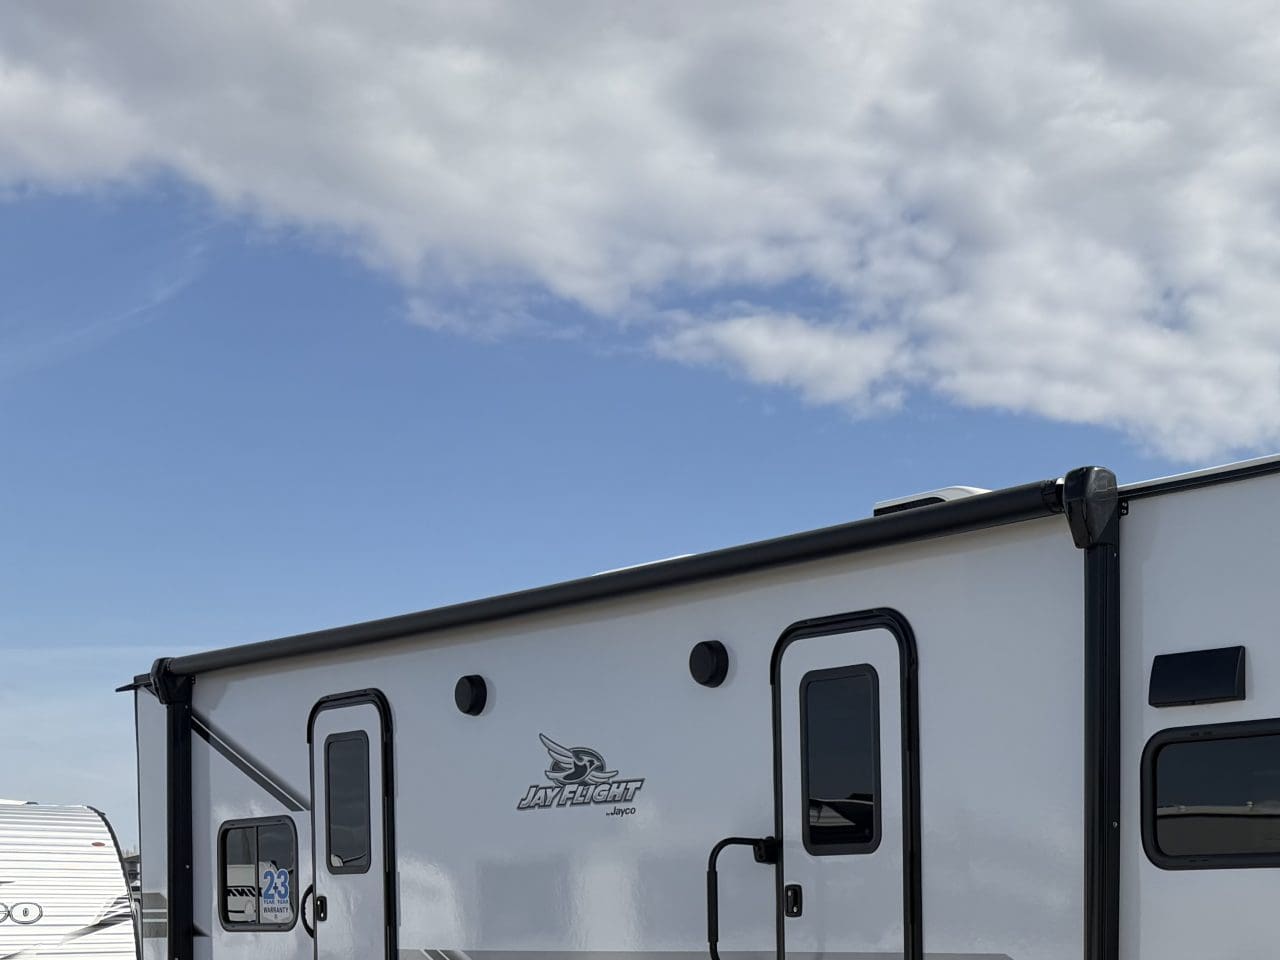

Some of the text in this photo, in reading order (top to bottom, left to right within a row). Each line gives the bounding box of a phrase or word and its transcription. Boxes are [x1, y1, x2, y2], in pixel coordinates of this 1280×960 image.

[517, 778, 645, 810] JAY FLIGHT
[611, 805, 636, 817] Jayco
[263, 906, 289, 914] WARRANTY
